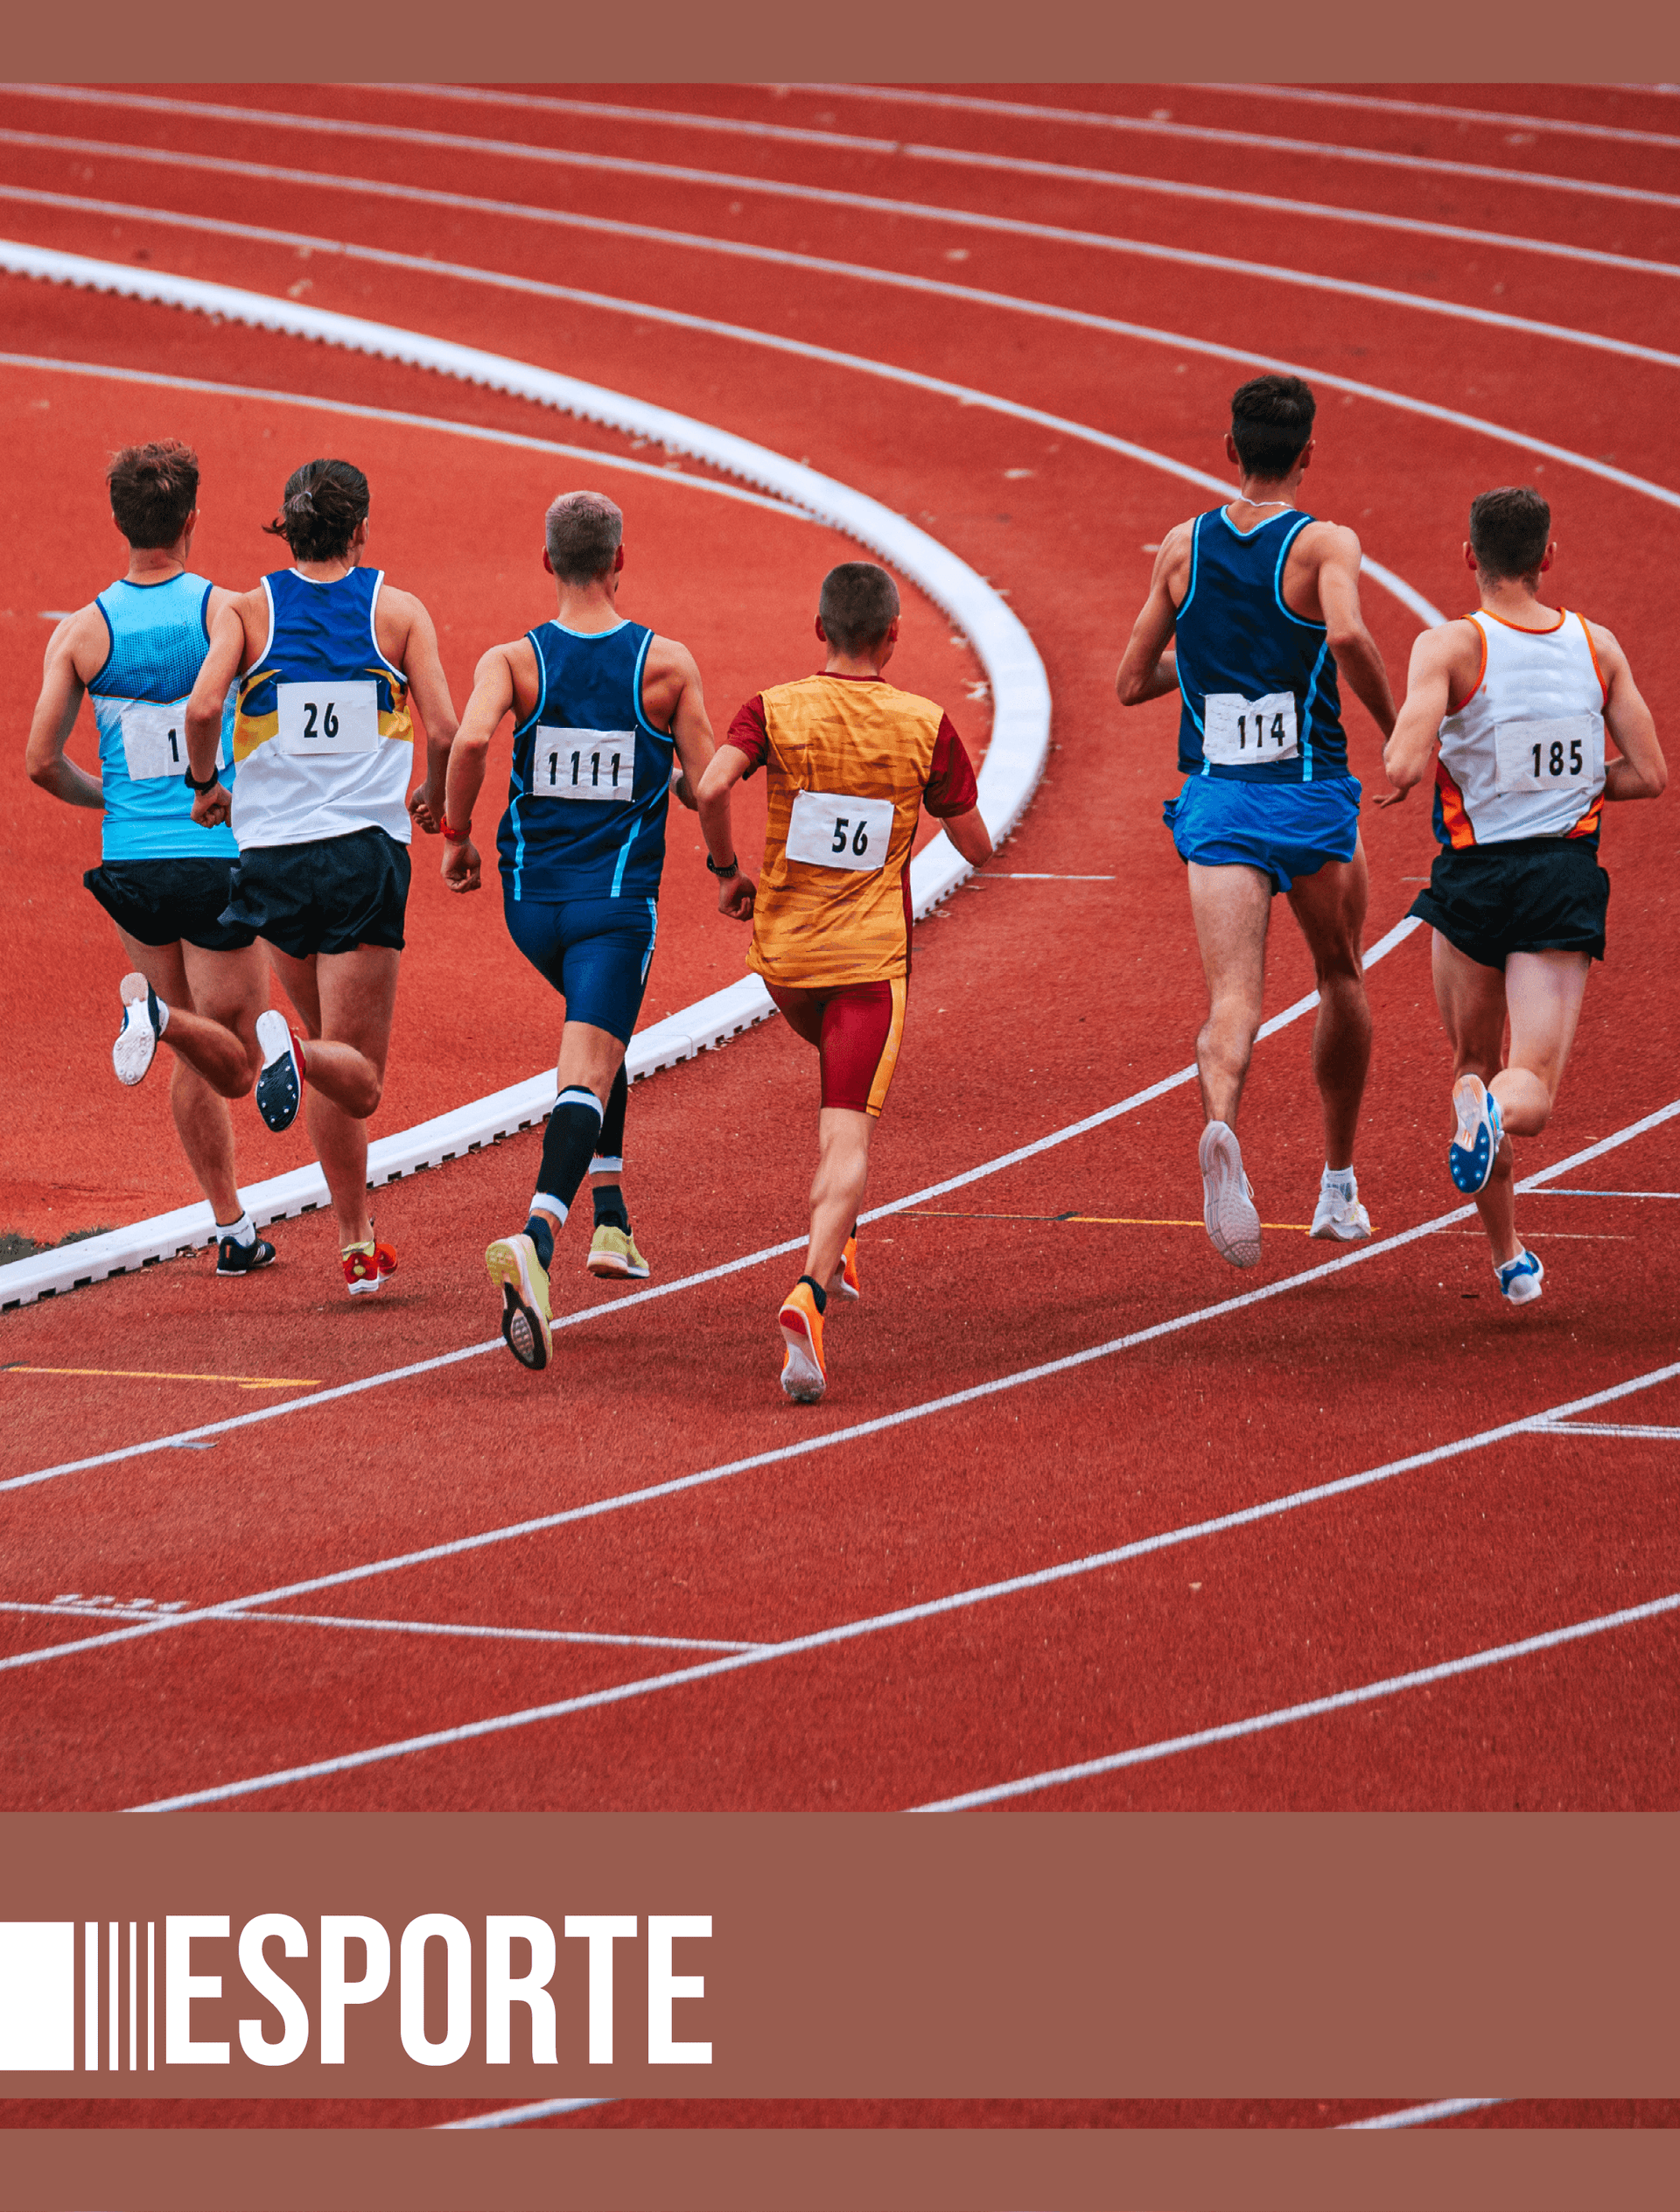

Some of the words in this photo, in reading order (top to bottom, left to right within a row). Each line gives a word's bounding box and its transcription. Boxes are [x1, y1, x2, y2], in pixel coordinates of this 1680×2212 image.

[304, 703, 339, 738] 26
[1237, 713, 1285, 749] 114
[549, 751, 620, 787] 1111
[1532, 739, 1582, 777] 185
[832, 817, 867, 856] 56
